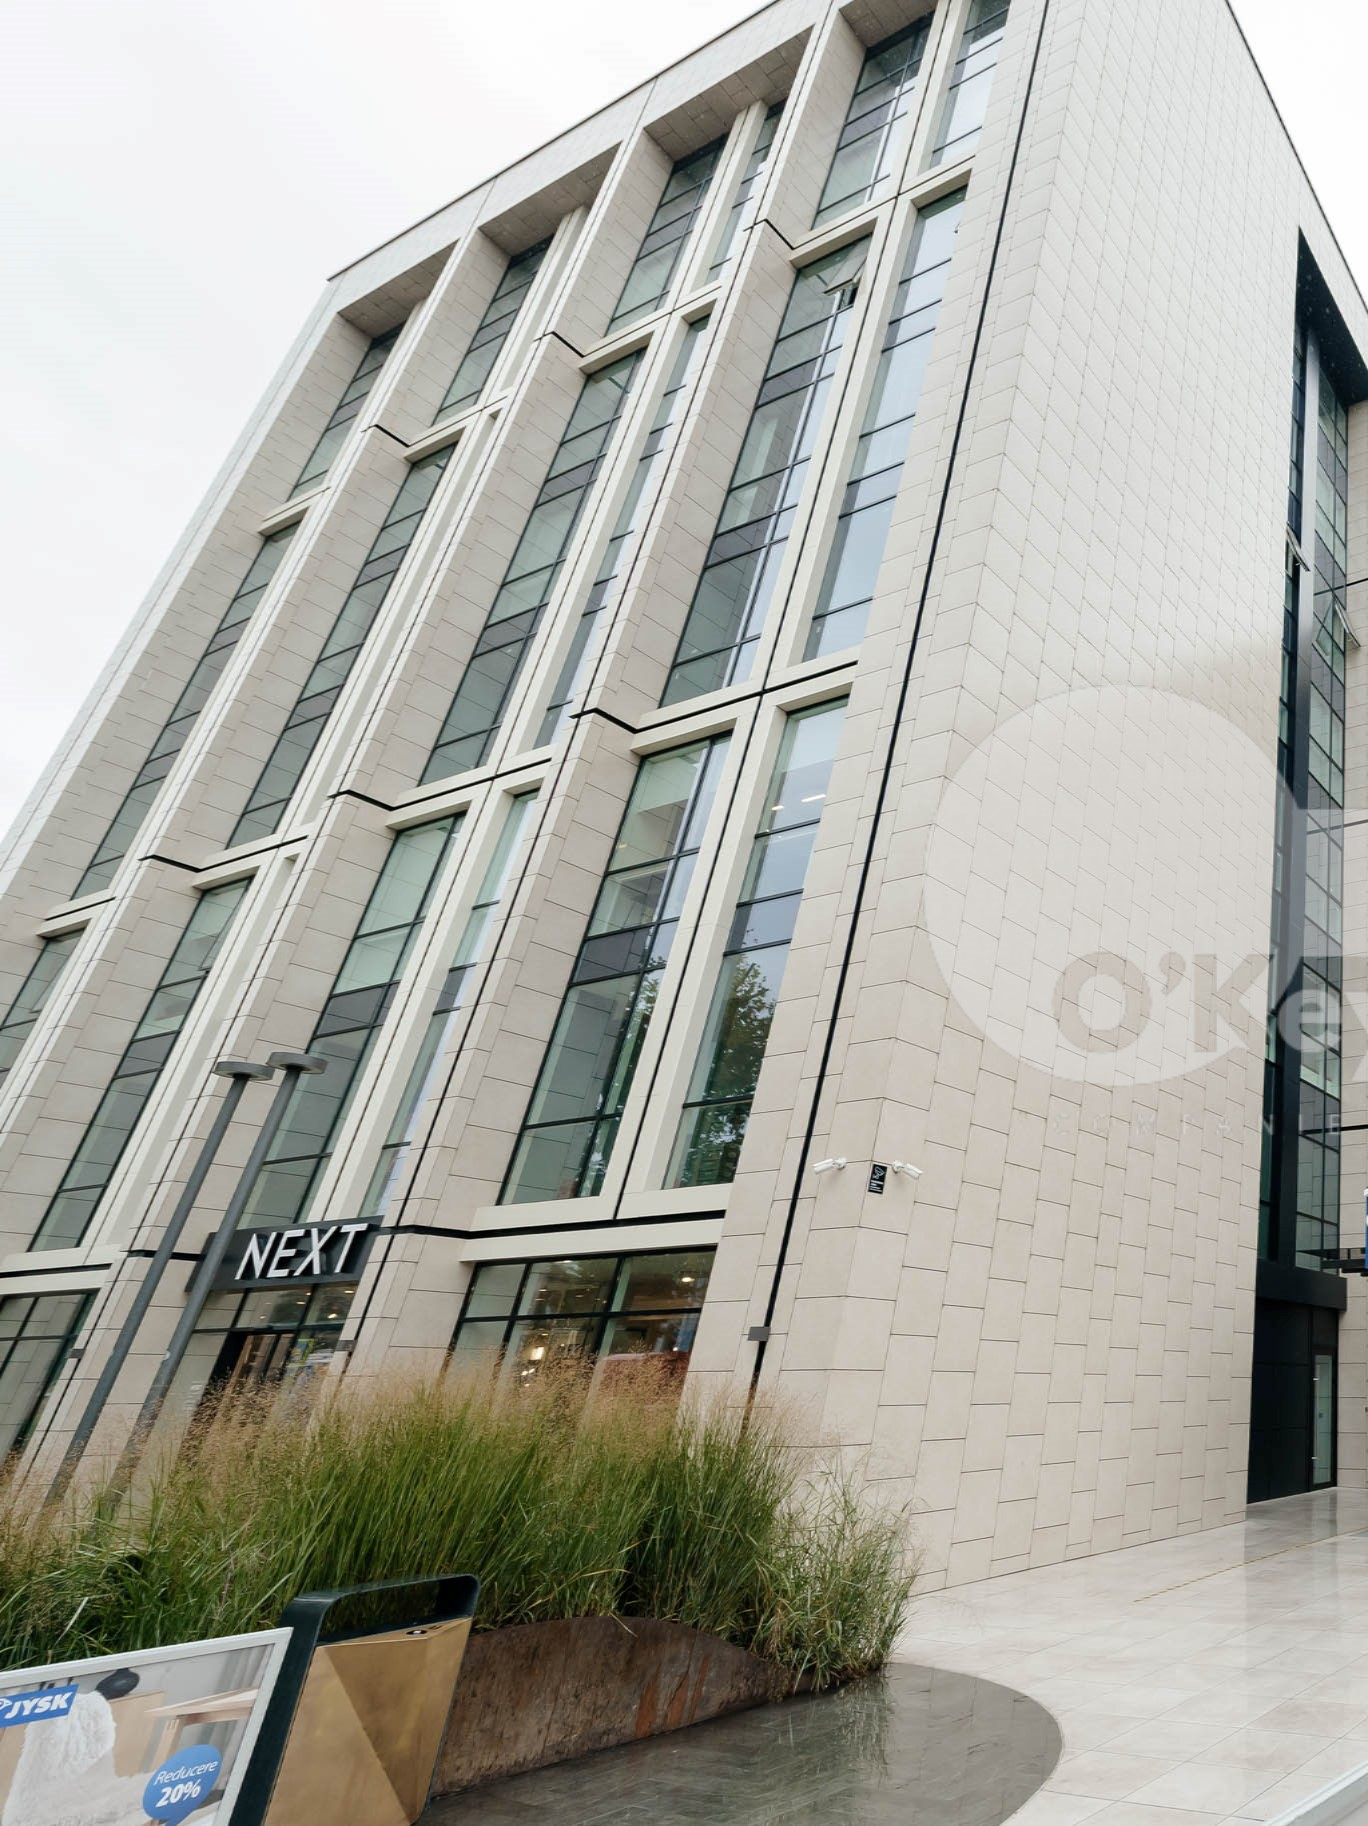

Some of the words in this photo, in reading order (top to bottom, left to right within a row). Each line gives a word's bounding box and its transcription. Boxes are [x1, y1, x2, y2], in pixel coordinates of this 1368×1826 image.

[234, 1223, 368, 1280] NEXT
[4, 1692, 72, 1719] JYSK
[154, 1760, 218, 1785] Reducere
[155, 1779, 201, 1808] 20%
